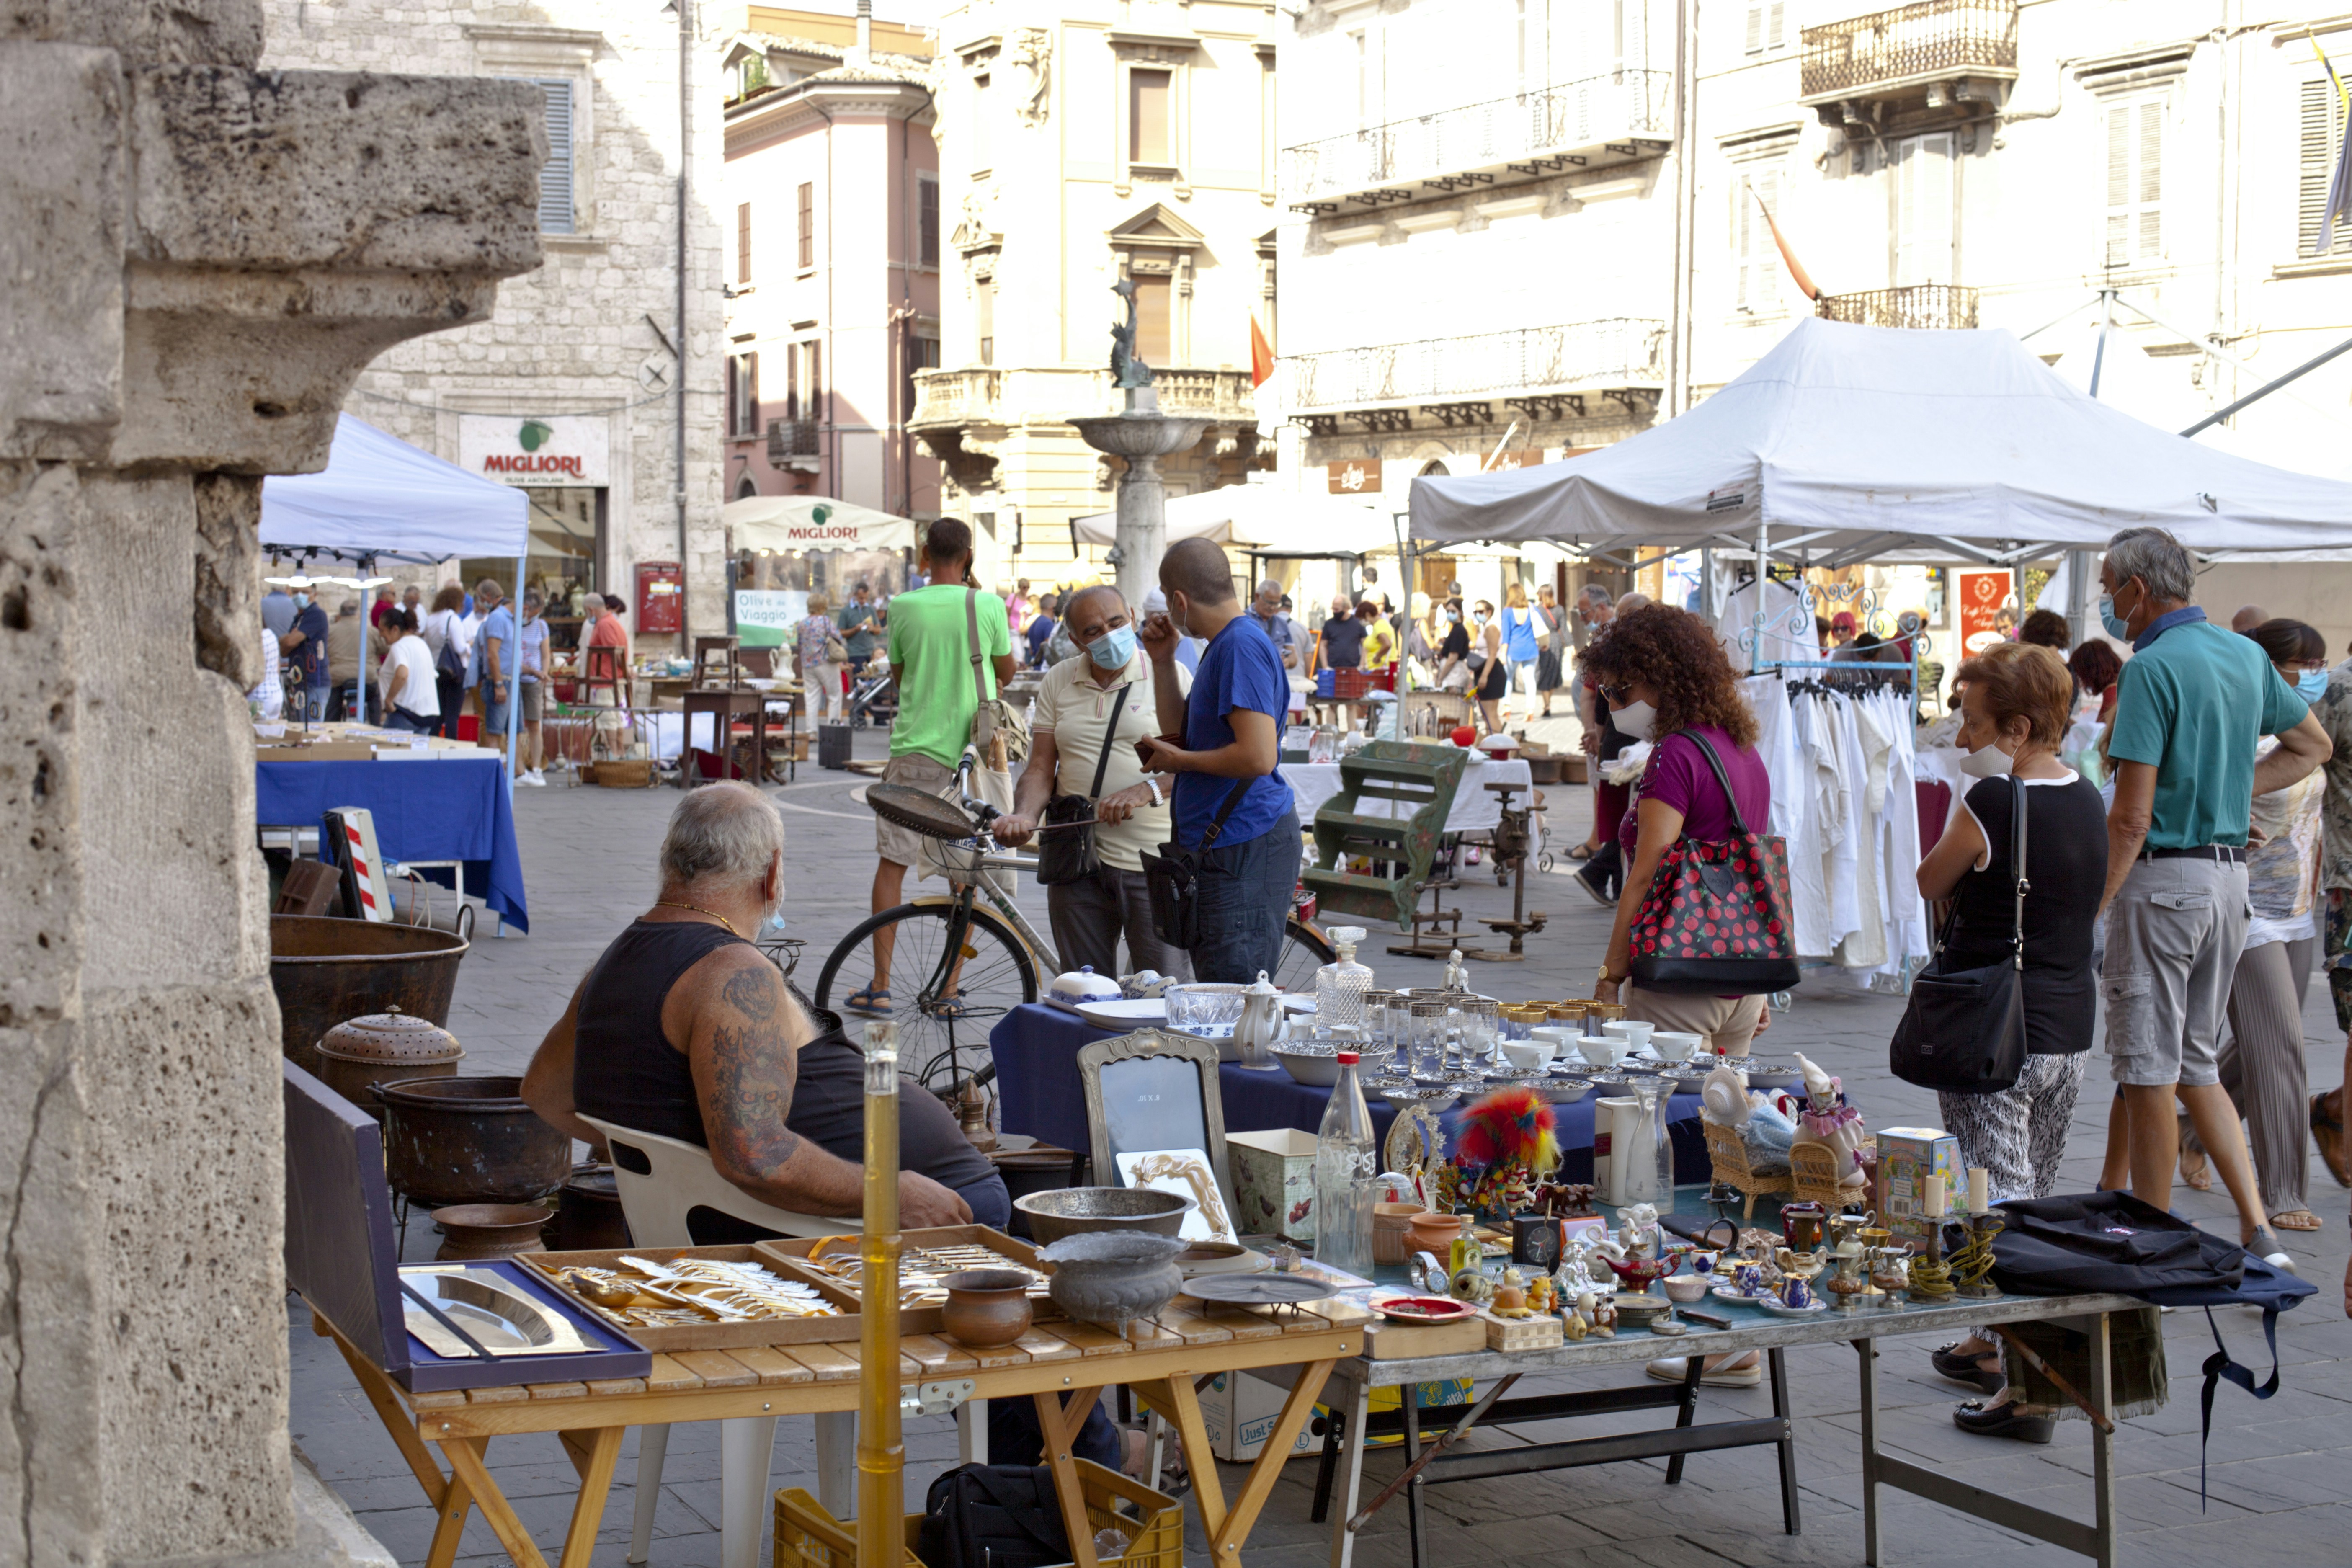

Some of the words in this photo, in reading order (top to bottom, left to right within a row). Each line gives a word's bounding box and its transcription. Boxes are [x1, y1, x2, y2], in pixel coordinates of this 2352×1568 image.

[485, 456, 585, 478] MIGLIORI
[788, 527, 860, 542] MIGLIORI
[739, 594, 771, 606] Olive
[740, 609, 786, 623] Viaggio
[1245, 1424, 1266, 1441] Just
[1299, 1436, 1305, 1446] L
